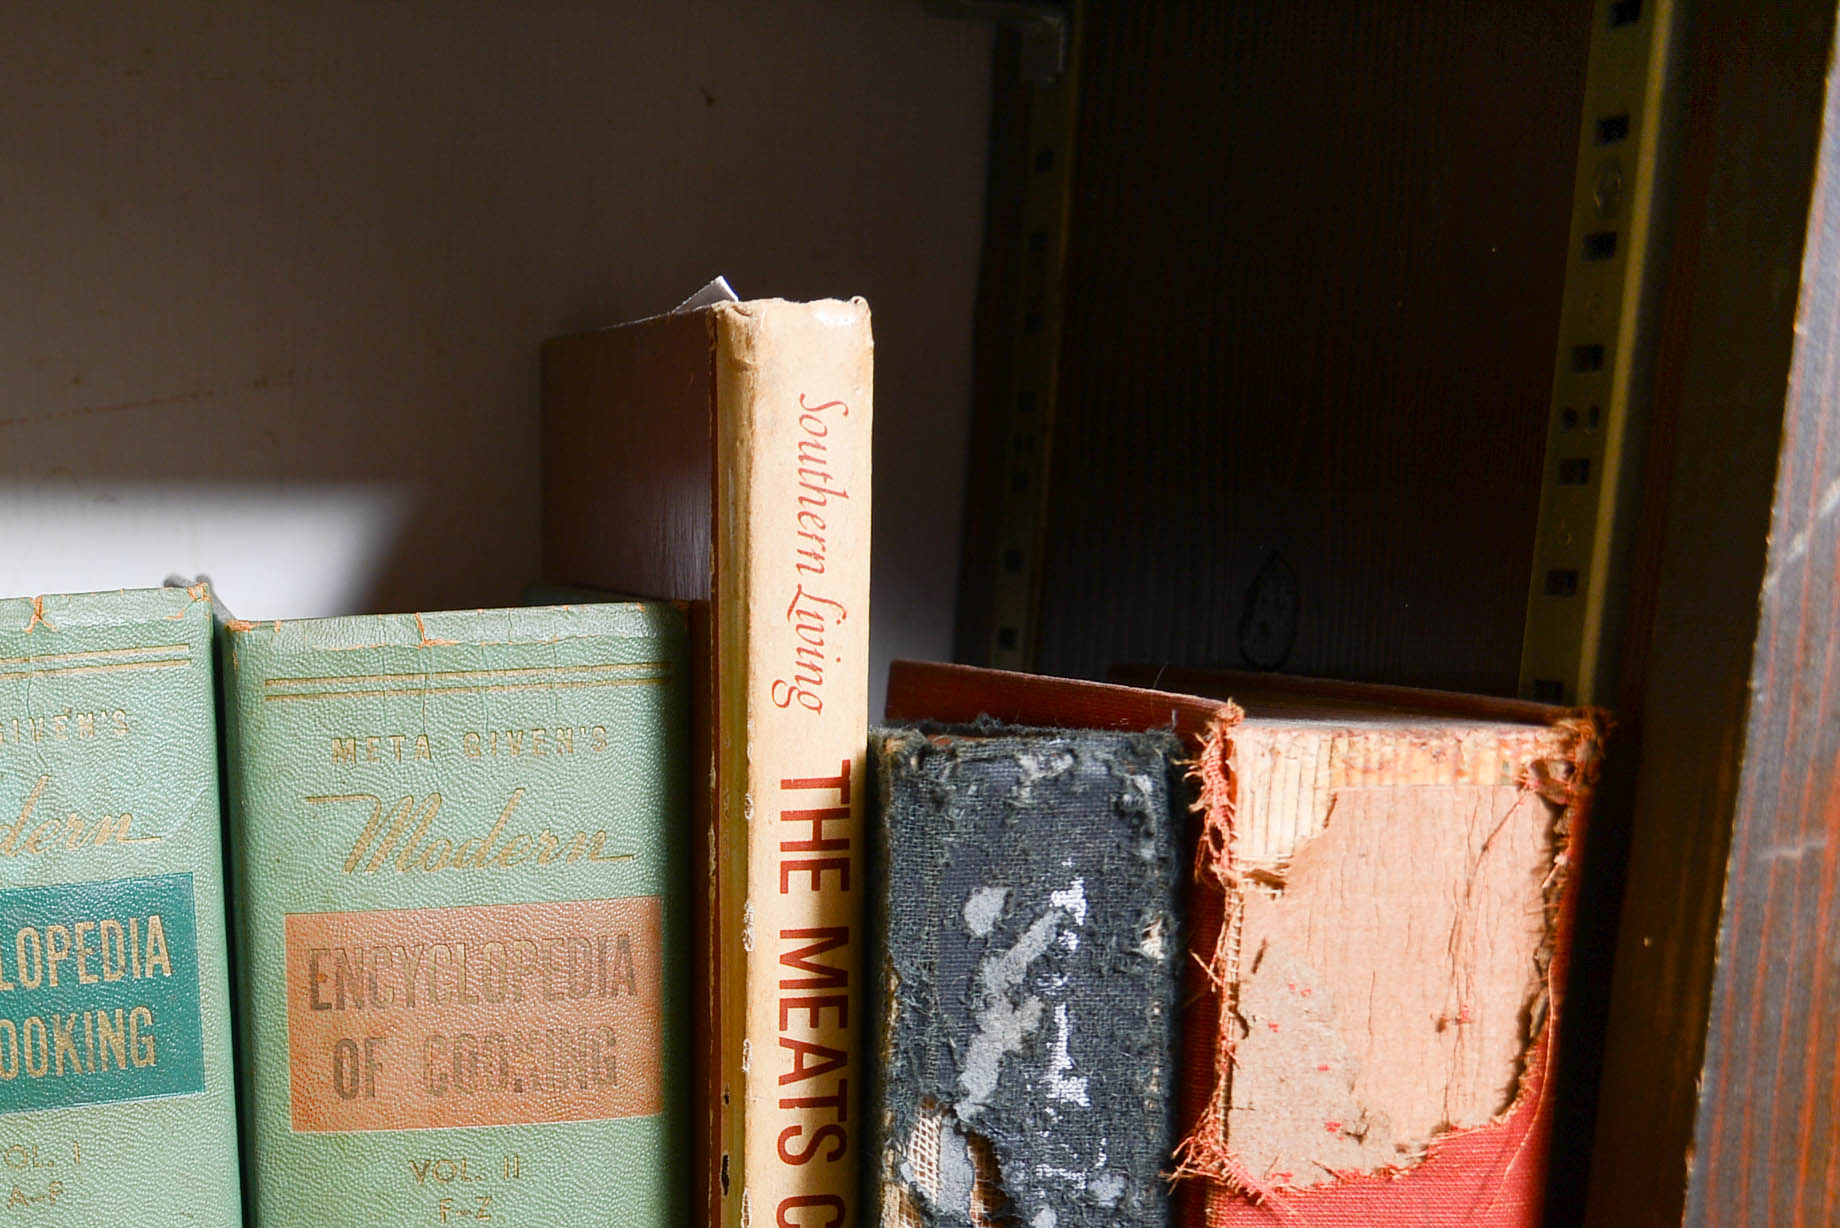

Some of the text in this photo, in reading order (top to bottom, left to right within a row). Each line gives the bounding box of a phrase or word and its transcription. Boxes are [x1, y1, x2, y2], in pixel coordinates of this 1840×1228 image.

[771, 393, 849, 716] Southern Living
[331, 725, 608, 765] META GIVEN'S
[305, 786, 634, 874] Modern
[779, 759, 850, 895] THE
[308, 934, 638, 1011] ENCYCLOPEDIA
[332, 1035, 386, 1100] OF
[777, 926, 848, 1167] MEATS
[409, 1155, 520, 1184] VOL. II
